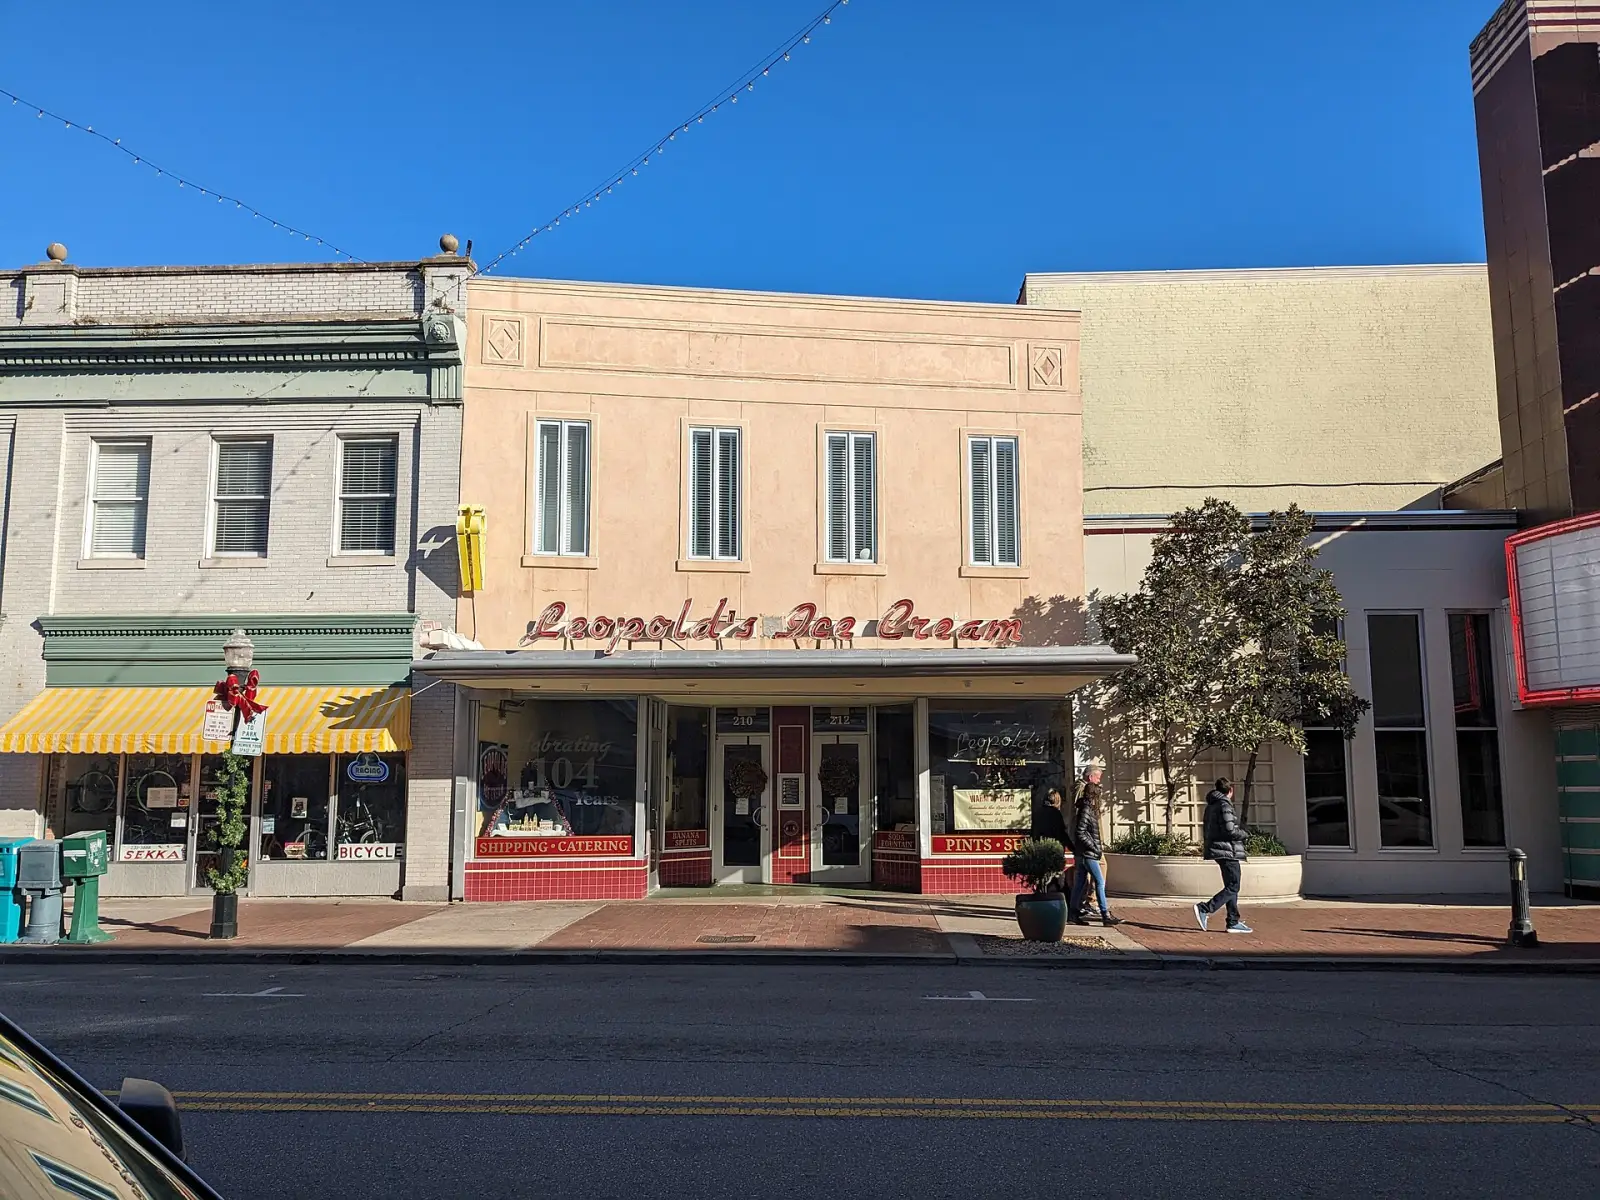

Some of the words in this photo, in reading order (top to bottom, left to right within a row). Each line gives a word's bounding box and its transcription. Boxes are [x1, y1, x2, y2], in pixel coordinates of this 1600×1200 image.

[517, 598, 759, 654] Leopold's
[772, 602, 857, 640] Ice
[876, 598, 1023, 642] Cream
[733, 716, 753, 726] 210
[830, 715, 851, 725] 212
[953, 728, 1045, 758] Leopold's
[976, 758, 992, 766] ICE
[993, 758, 1026, 766] CREAM
[534, 757, 600, 789] 104
[574, 790, 619, 806] Years
[672, 832, 700, 840] BANANA
[888, 833, 905, 842] SODA
[479, 842, 549, 853] SHIPPING
[557, 840, 629, 852] CATERING
[674, 838, 697, 847] SPLITS
[880, 840, 913, 849] FOUNTAIN
[945, 838, 992, 852] PINTS
[123, 850, 180, 859] SEKKA
[339, 846, 404, 859] BICYCLE
